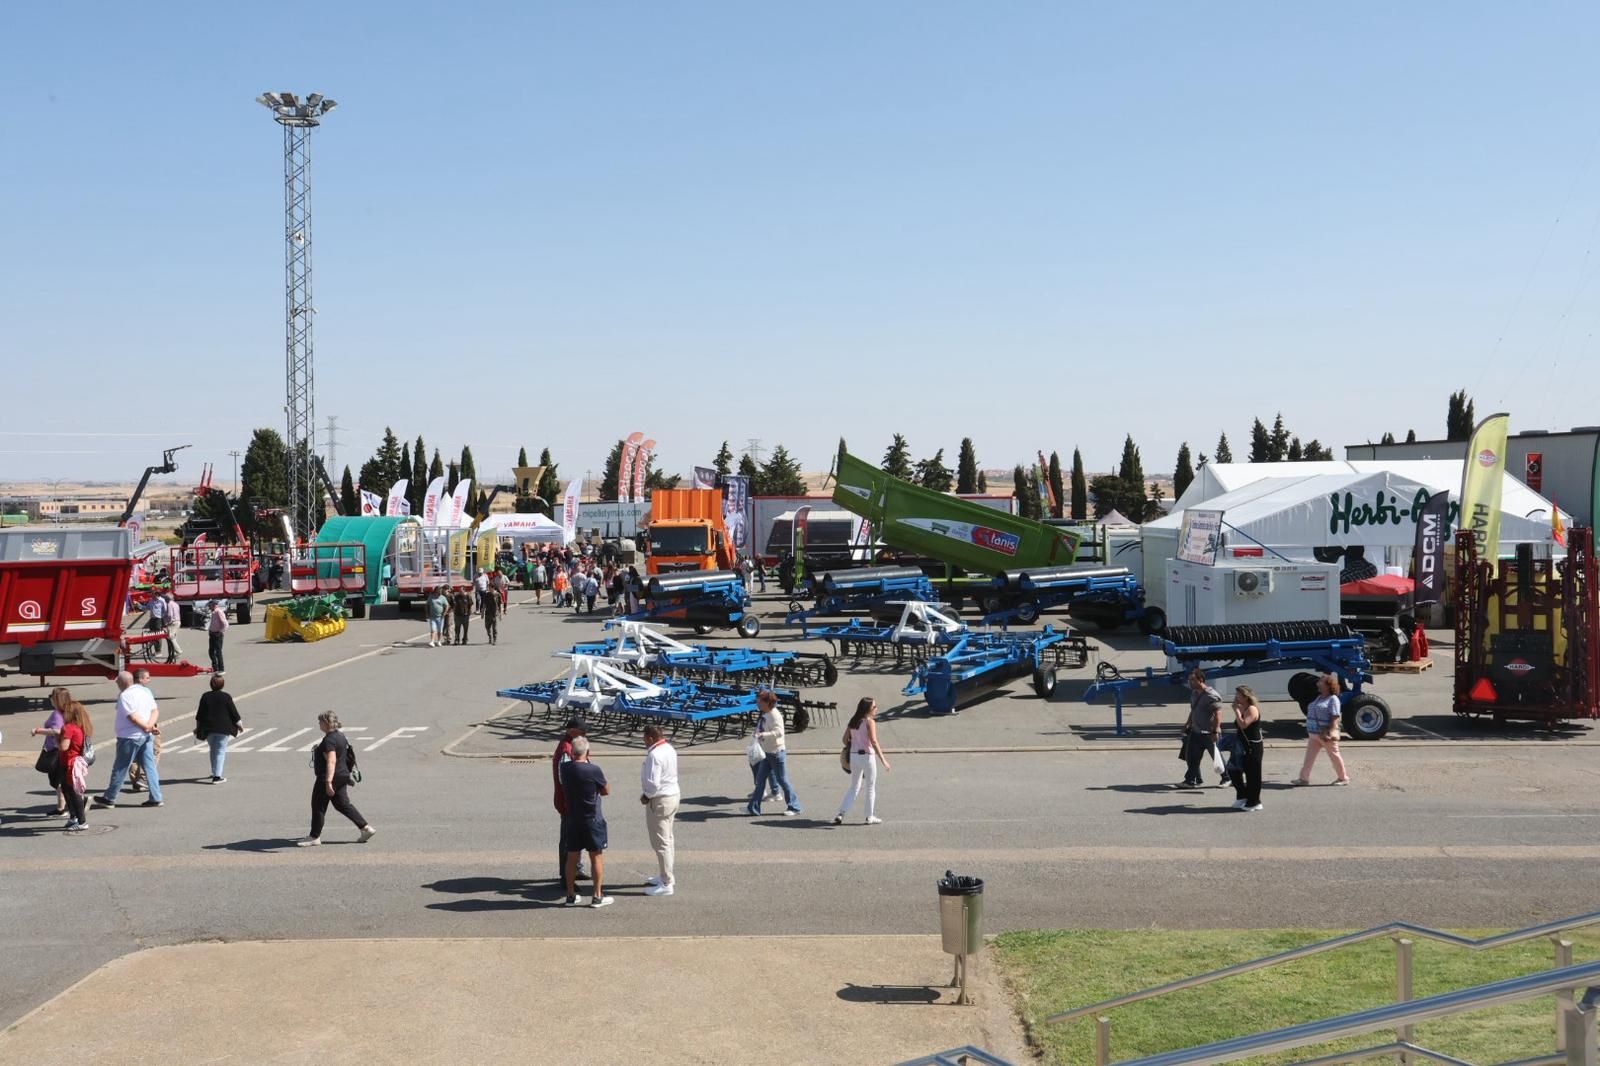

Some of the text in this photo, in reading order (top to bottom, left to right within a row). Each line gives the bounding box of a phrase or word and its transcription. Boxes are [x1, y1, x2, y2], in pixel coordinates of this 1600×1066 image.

[426, 494, 436, 522] YAMAHA
[453, 495, 462, 523] YAMAHA
[565, 495, 574, 522] YAMAHA
[1422, 514, 1437, 573] DCM
